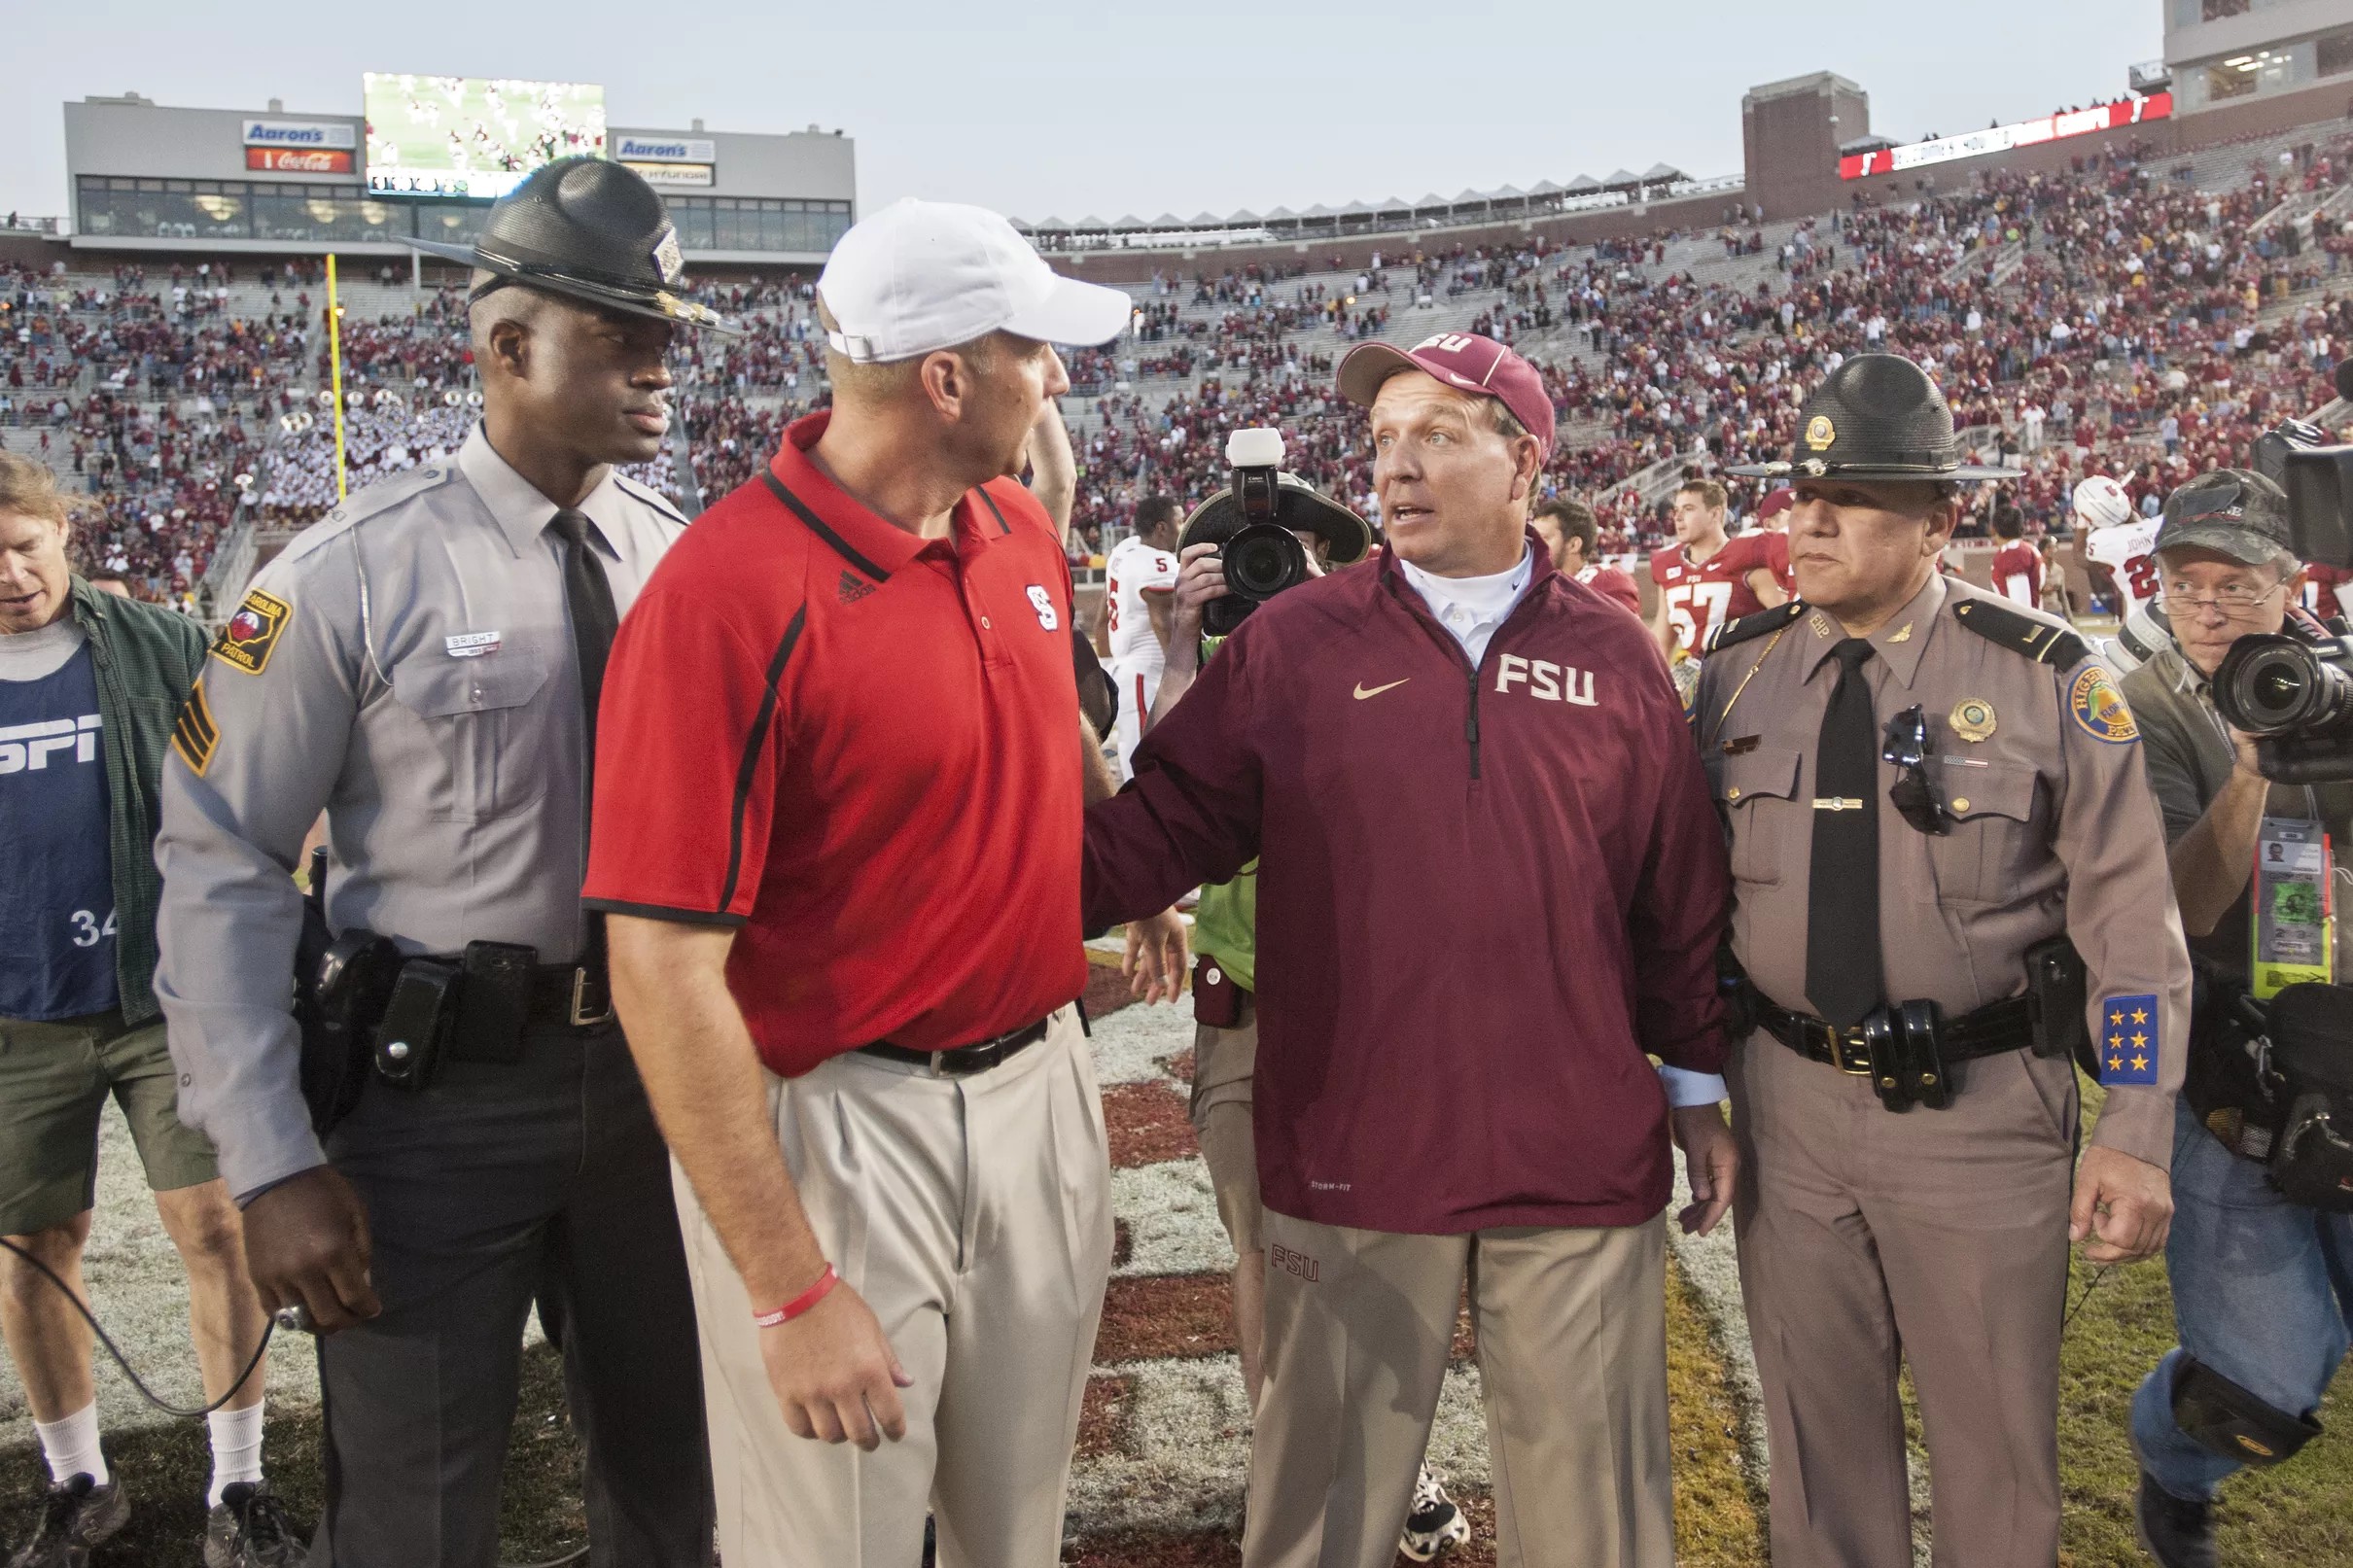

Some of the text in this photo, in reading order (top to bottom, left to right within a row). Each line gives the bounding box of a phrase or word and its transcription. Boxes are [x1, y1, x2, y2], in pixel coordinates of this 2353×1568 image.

[1155, 558, 1168, 573] 5
[1666, 581, 1733, 651] 57
[452, 634, 493, 646] BRIGHT
[221, 642, 256, 668] PATROL
[1494, 653, 1599, 707] FSU
[1311, 1180, 1352, 1192] STORM-FIT
[1271, 1243, 1319, 1282] FSU
